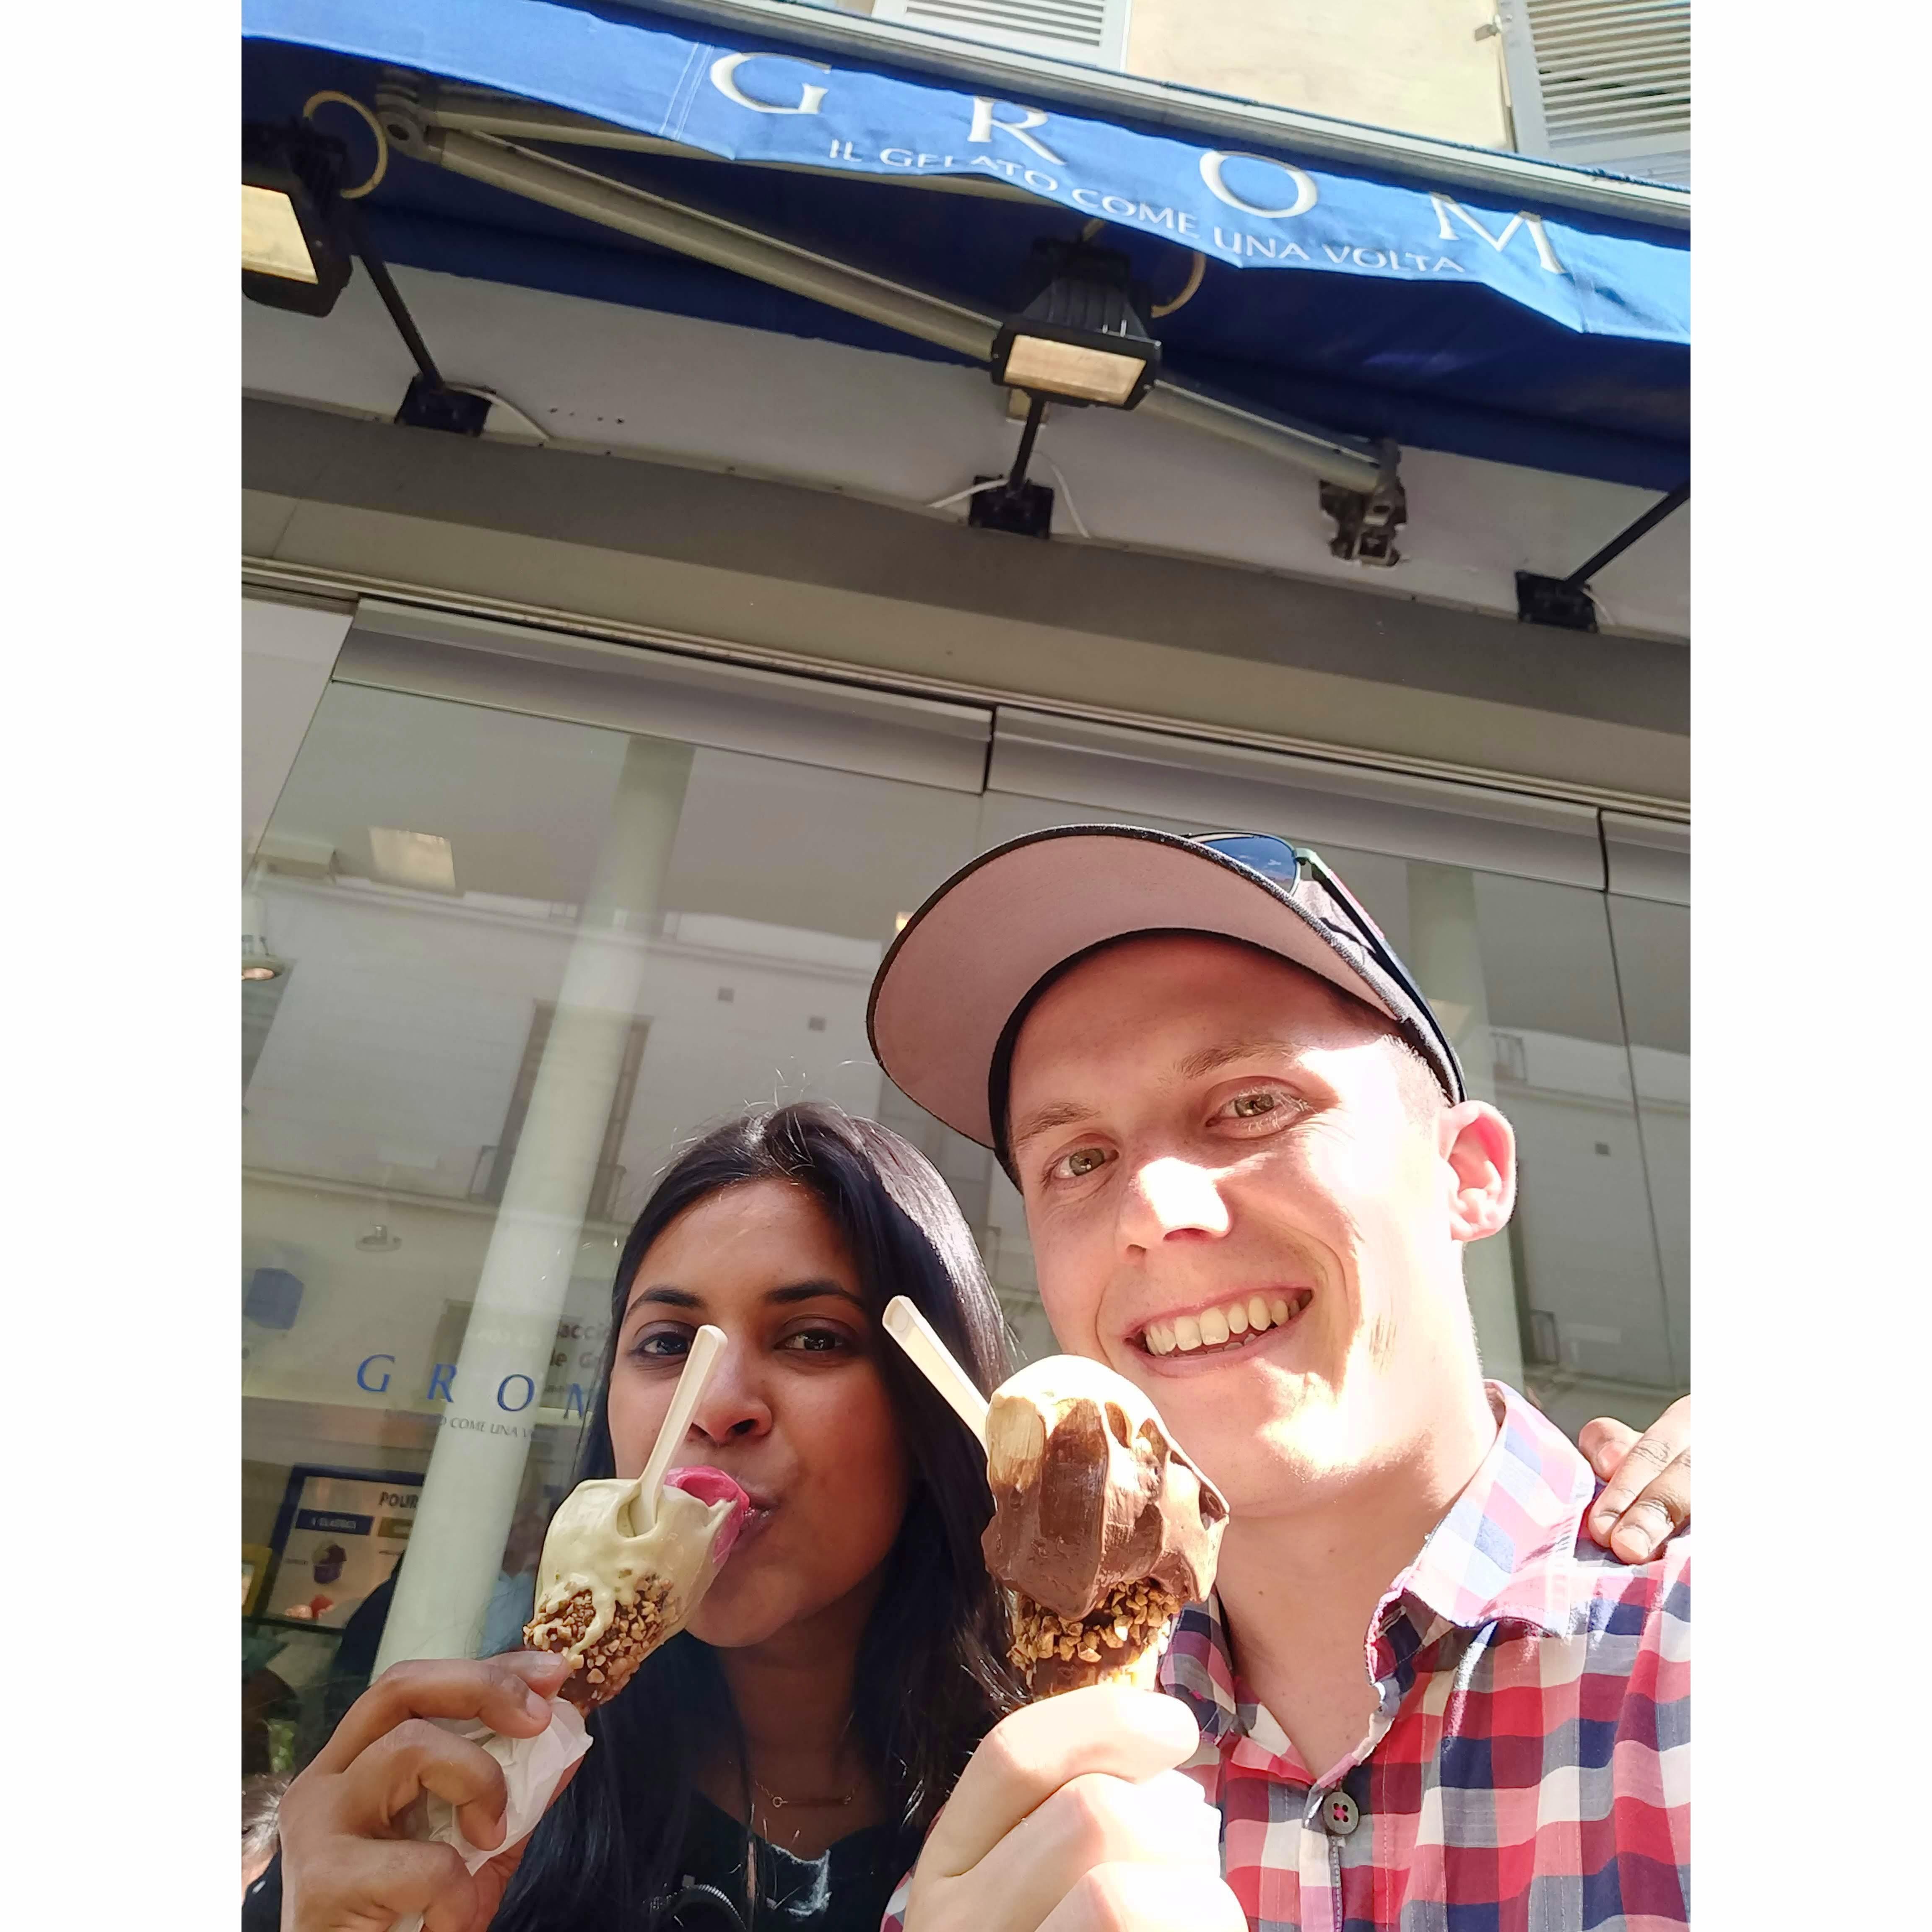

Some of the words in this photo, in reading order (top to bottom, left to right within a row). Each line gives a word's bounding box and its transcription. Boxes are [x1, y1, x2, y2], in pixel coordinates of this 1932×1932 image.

[709, 51, 1567, 275] GROM
[829, 139, 862, 162] IL
[880, 148, 1059, 191] GELATO
[1072, 188, 1200, 239] COME
[1213, 226, 1311, 261] UNA
[1321, 243, 1465, 273] VOLTA
[450, 1416, 486, 1433] COME
[490, 1425, 518, 1439] UNA
